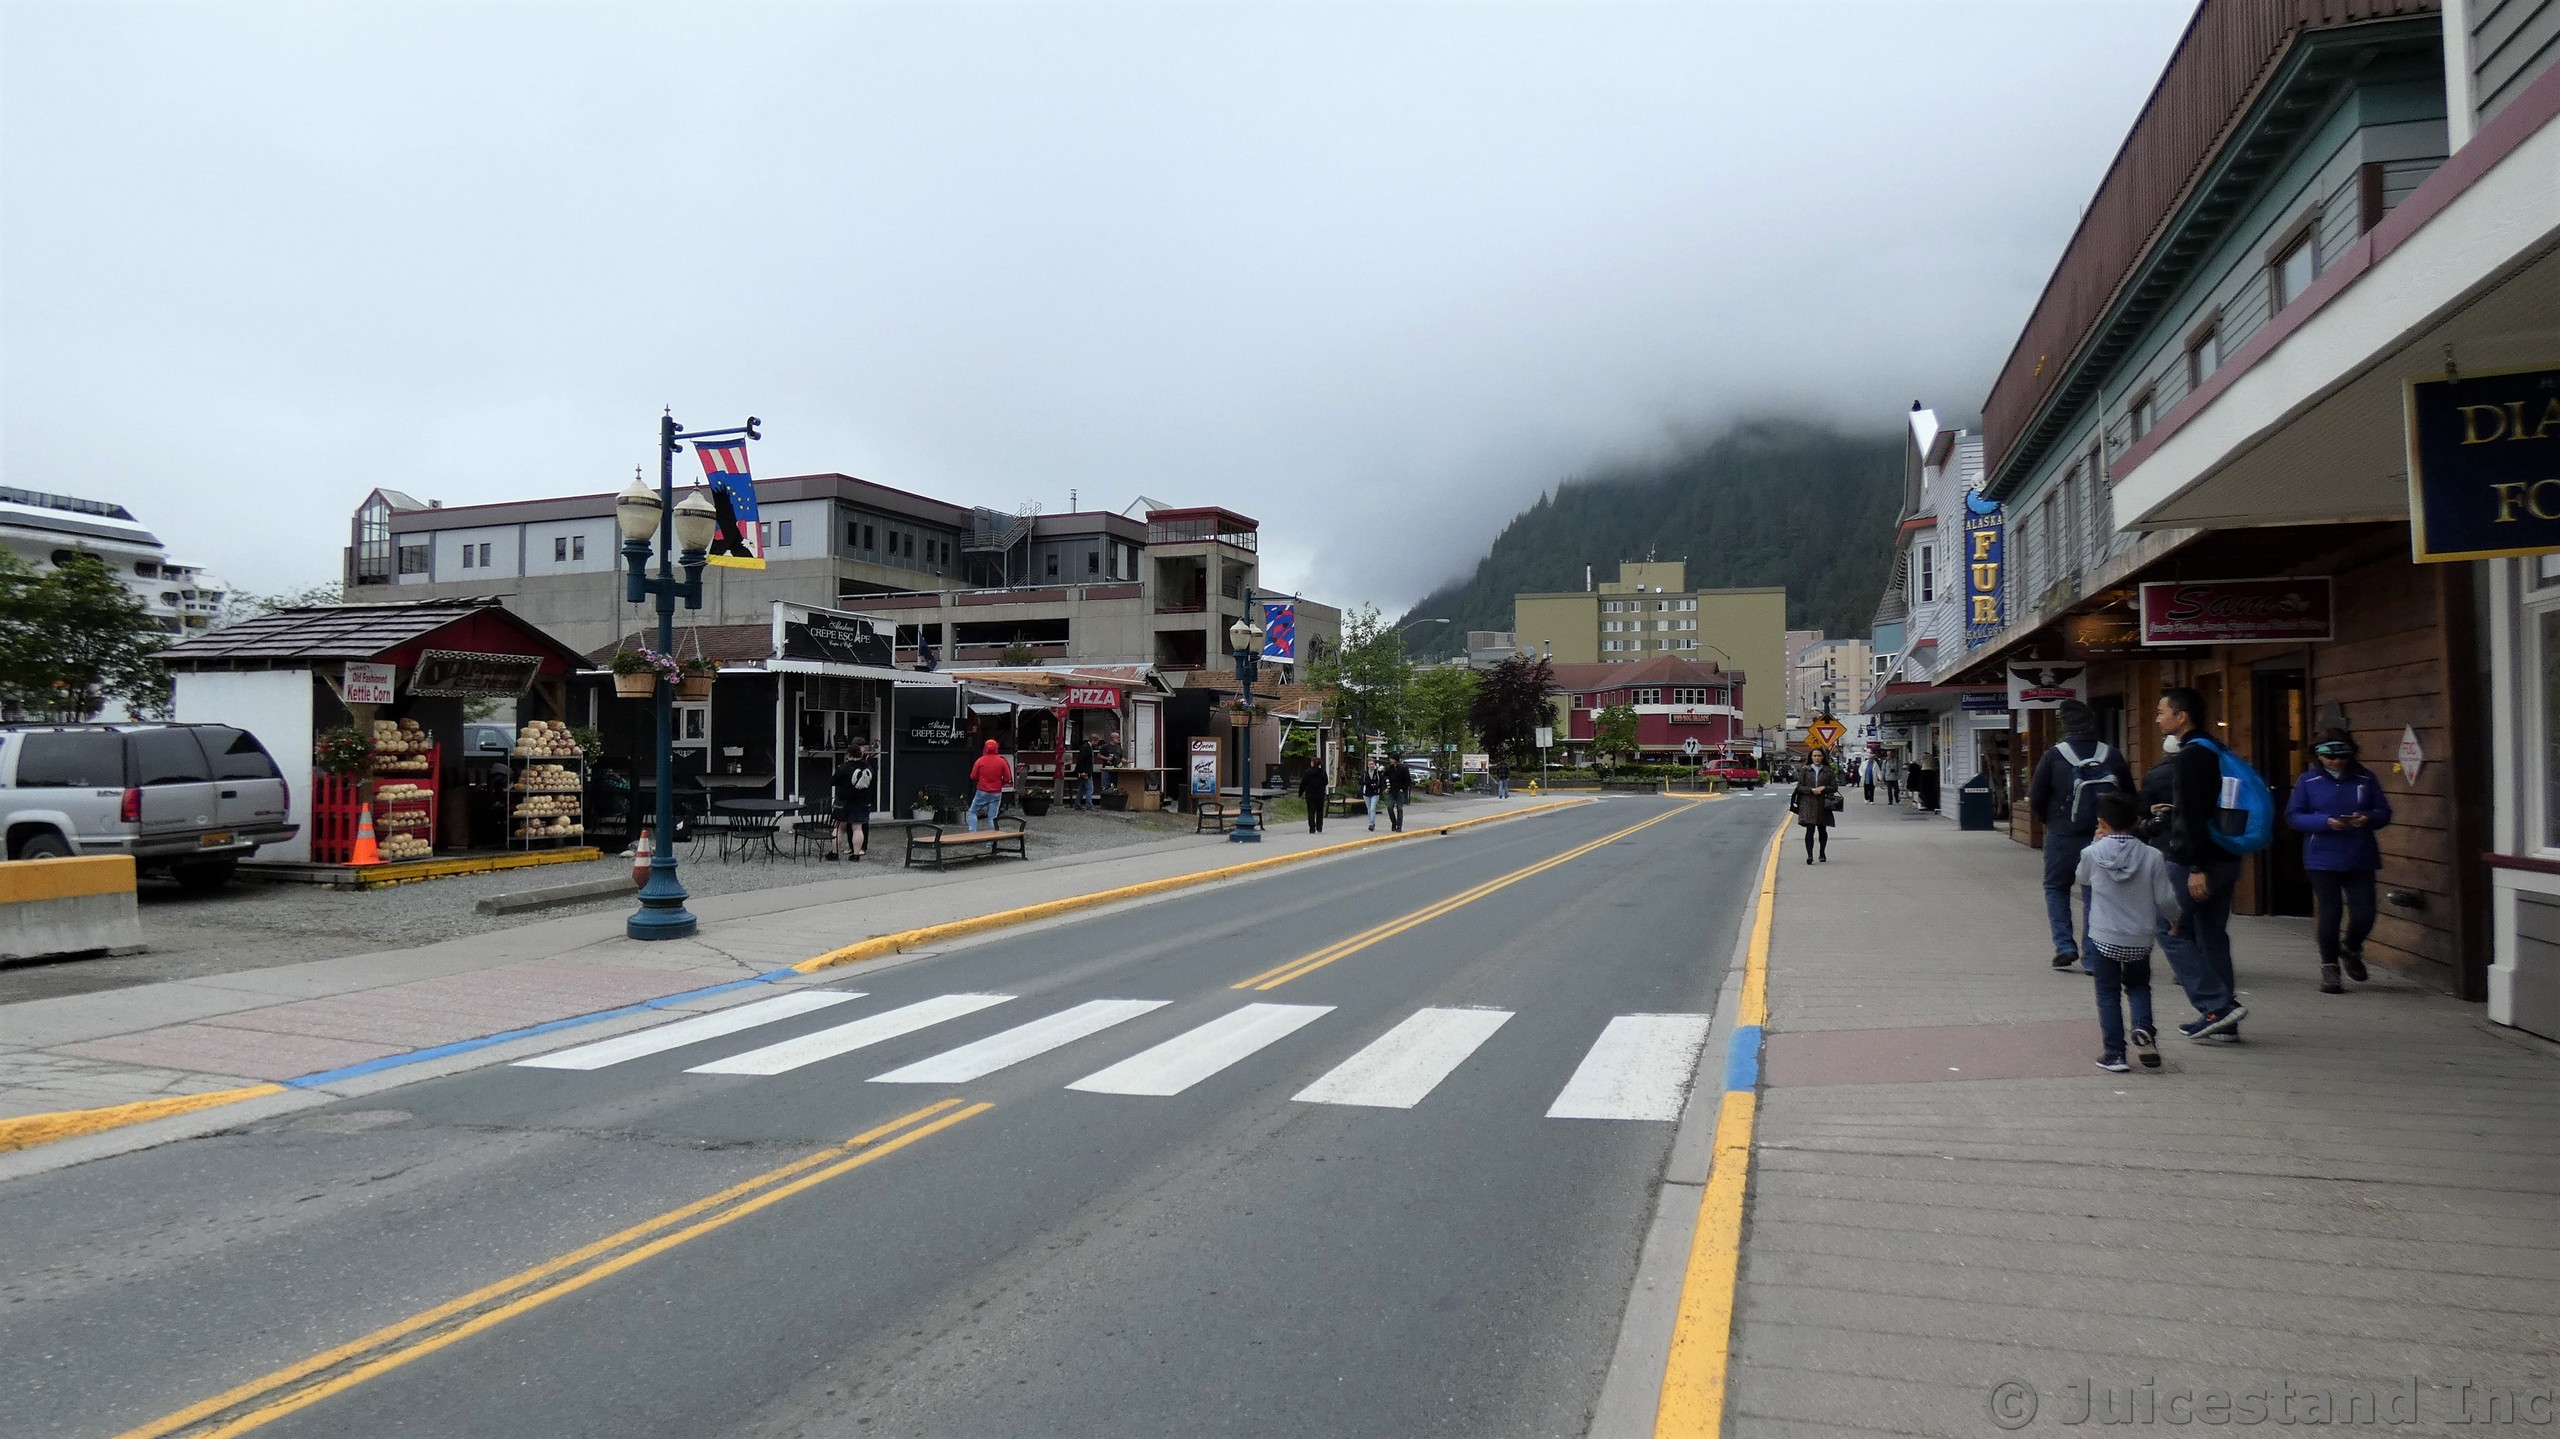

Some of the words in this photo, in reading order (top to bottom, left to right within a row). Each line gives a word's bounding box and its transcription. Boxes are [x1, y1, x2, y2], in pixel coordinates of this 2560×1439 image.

[1965, 515, 2003, 530] ALASKA
[1971, 531, 1999, 624] FUR
[2165, 585, 2276, 620] Sam
[347, 684, 371, 701] Kettle
[373, 686, 390, 702] Corn
[1070, 688, 1116, 706] PIZZA
[1962, 693, 1996, 702] Diamond
[1193, 741, 1214, 751] Open
